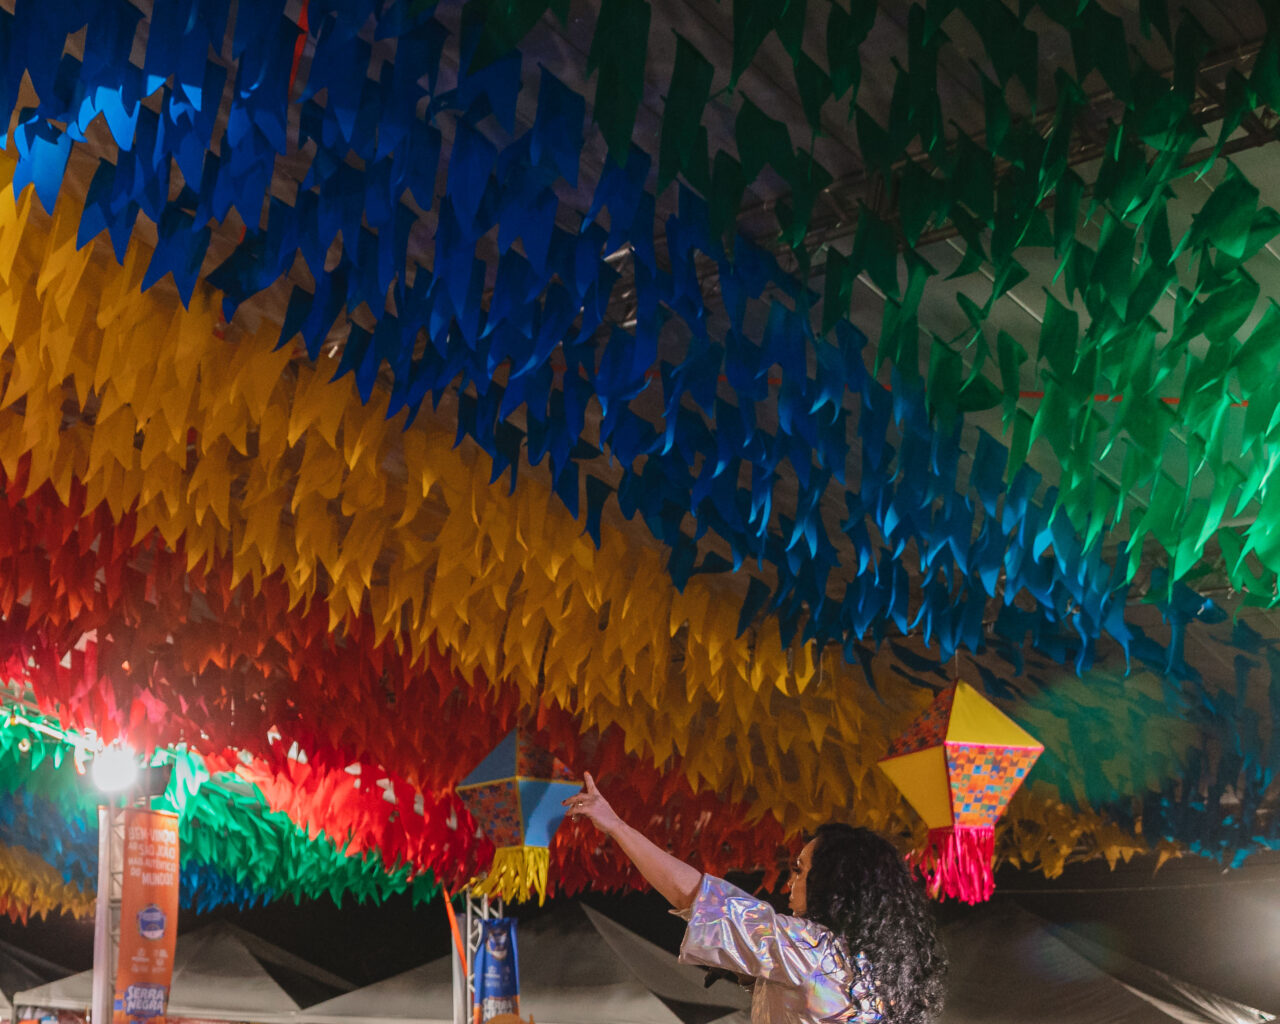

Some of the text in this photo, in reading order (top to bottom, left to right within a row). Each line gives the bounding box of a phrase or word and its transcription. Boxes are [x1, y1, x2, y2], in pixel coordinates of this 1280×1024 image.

[157, 843, 176, 860] JOÃO
[127, 984, 164, 1000] SERRA
[126, 999, 164, 1016] NEGRA
